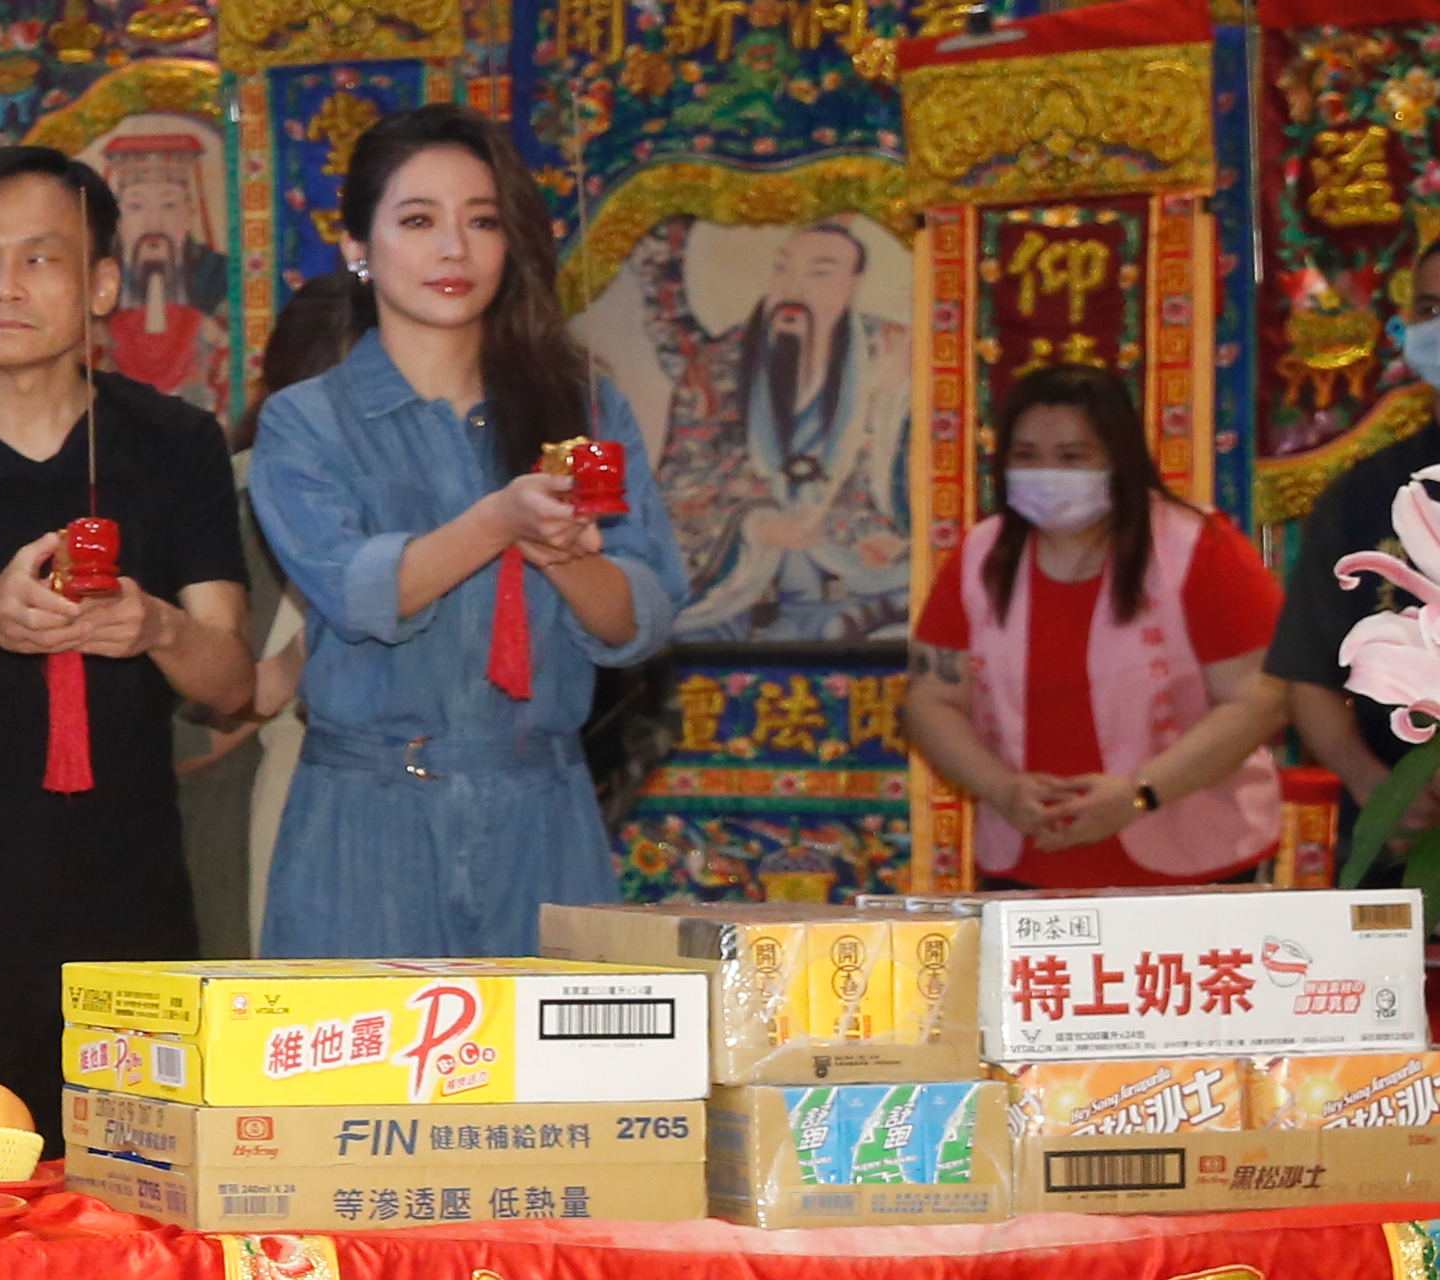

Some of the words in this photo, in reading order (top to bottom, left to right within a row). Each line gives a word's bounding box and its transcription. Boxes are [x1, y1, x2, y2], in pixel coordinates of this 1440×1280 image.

[1009, 948, 1257, 1023] 特上奶茶
[267, 1016, 386, 1074] 維他露
[404, 985, 477, 1098] P
[333, 1118, 419, 1157] FIN
[430, 1123, 592, 1150] 健康補給飲料
[616, 1116, 690, 1140] 2765
[1228, 1165, 1327, 1191] 黑松沙士
[333, 1186, 472, 1221] 等滲透壓
[488, 1186, 592, 1220] 低熱量
